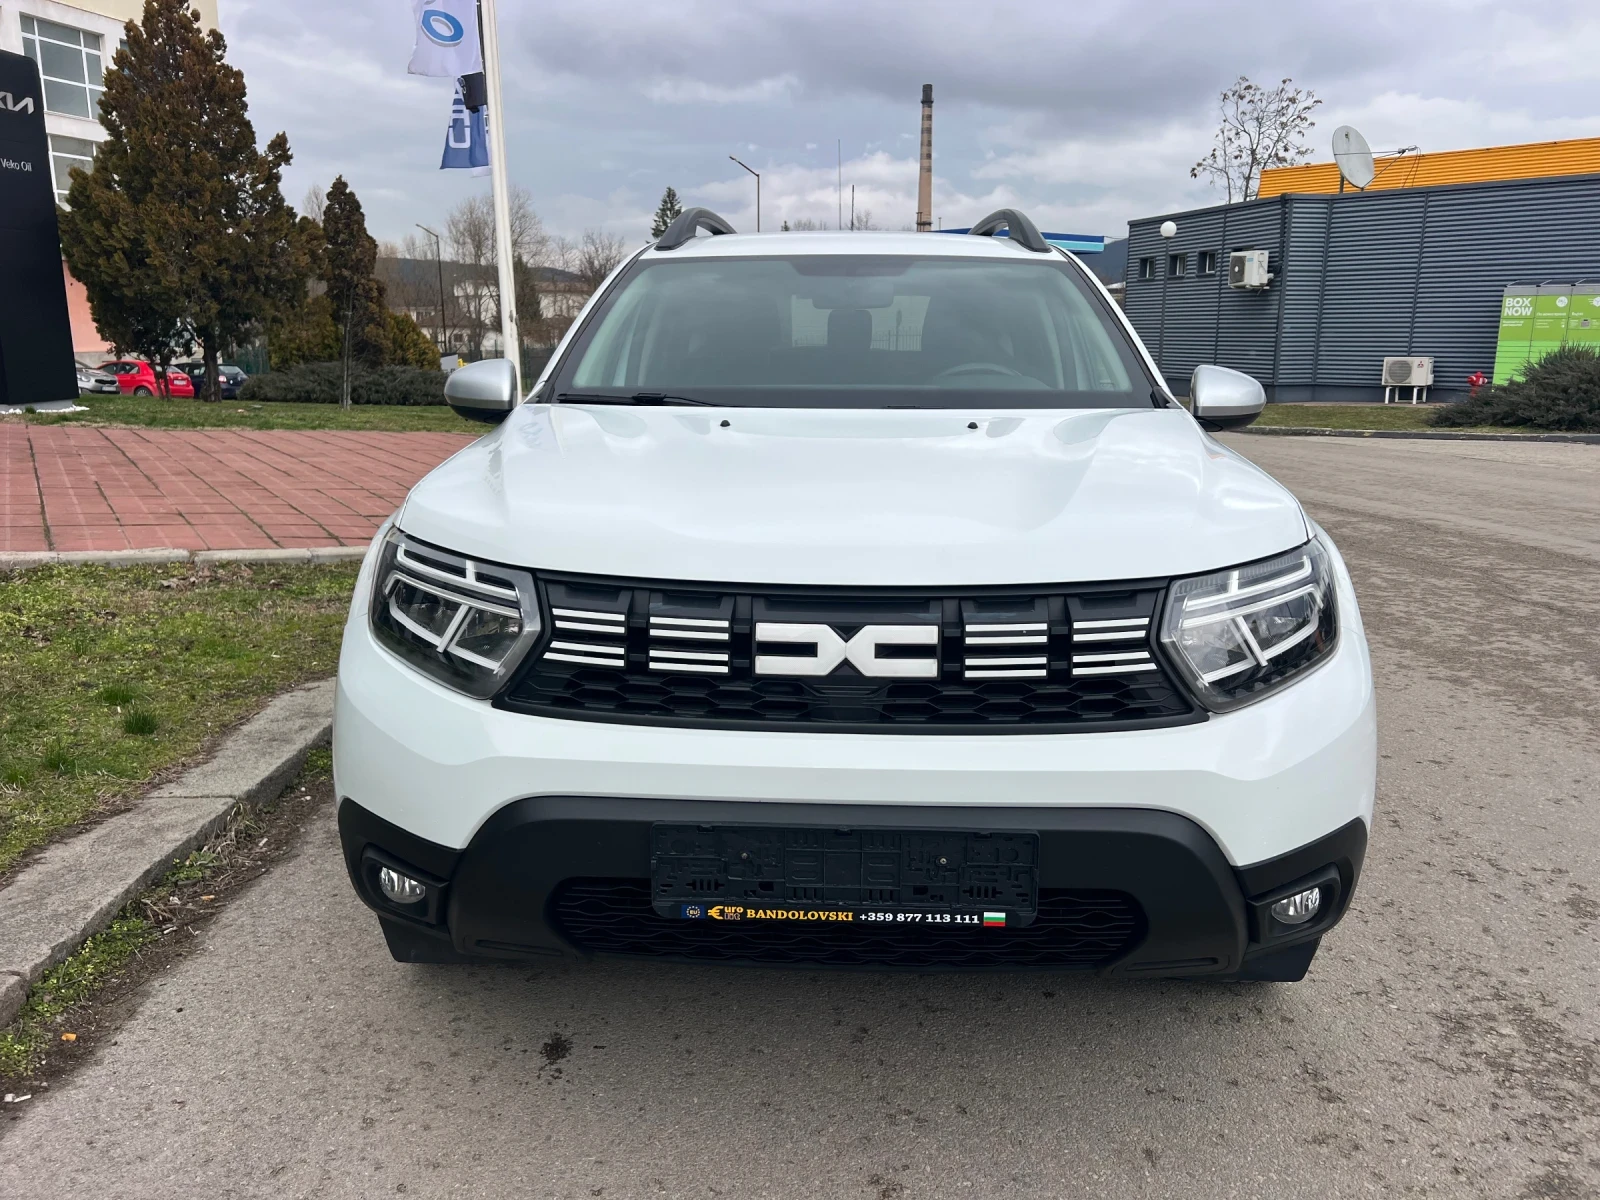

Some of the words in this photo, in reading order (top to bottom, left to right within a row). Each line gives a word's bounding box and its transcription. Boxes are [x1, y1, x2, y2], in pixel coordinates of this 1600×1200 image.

[0, 158, 20, 170] Veko
[20, 161, 33, 172] Oil
[1505, 298, 1532, 307] BOX
[1503, 307, 1533, 316] NOW
[746, 909, 853, 921] BANDOLOVSKI
[859, 912, 893, 922] +359
[896, 912, 922, 922] 877
[925, 913, 951, 923] 113
[954, 914, 980, 924] 111
